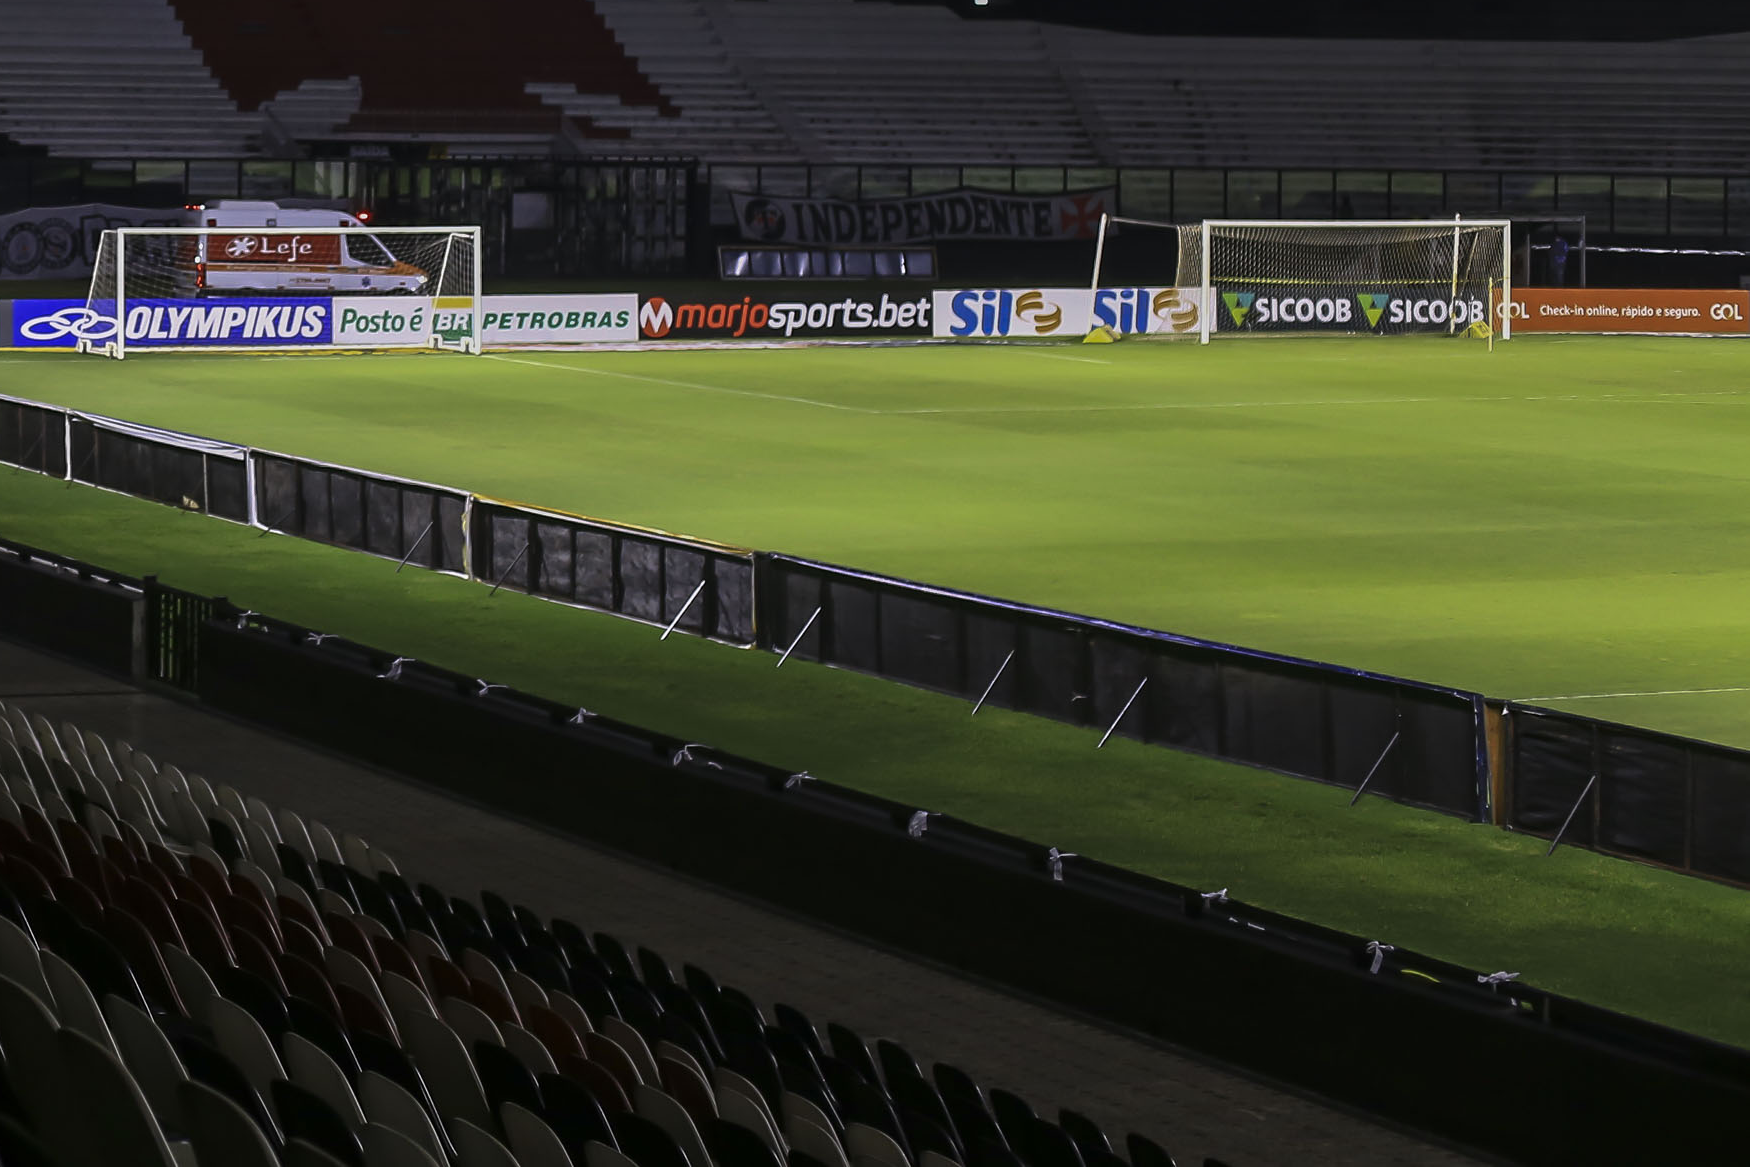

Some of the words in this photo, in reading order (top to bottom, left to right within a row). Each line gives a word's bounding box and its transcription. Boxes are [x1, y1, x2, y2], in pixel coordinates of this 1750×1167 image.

[792, 194, 1051, 240] INDEPENDENTE
[260, 236, 313, 263] Lefe
[126, 305, 327, 340] OLYMPIKUS
[340, 308, 402, 334] Posto
[410, 306, 424, 332] é
[435, 313, 469, 331] BR
[482, 312, 630, 331] PETROBRAS
[676, 293, 932, 337] marjosports.bet
[949, 290, 1013, 336] Sil
[1093, 289, 1149, 334] Sil
[1256, 297, 1352, 324] SICOOB
[1389, 299, 1484, 324] SICOOB
[1539, 304, 1584, 317] Check-in
[1586, 304, 1620, 318] online,
[1621, 304, 1654, 319] rápido
[1655, 307, 1662, 317] e
[1664, 307, 1701, 320] seguro.
[1710, 303, 1743, 321] GOL
